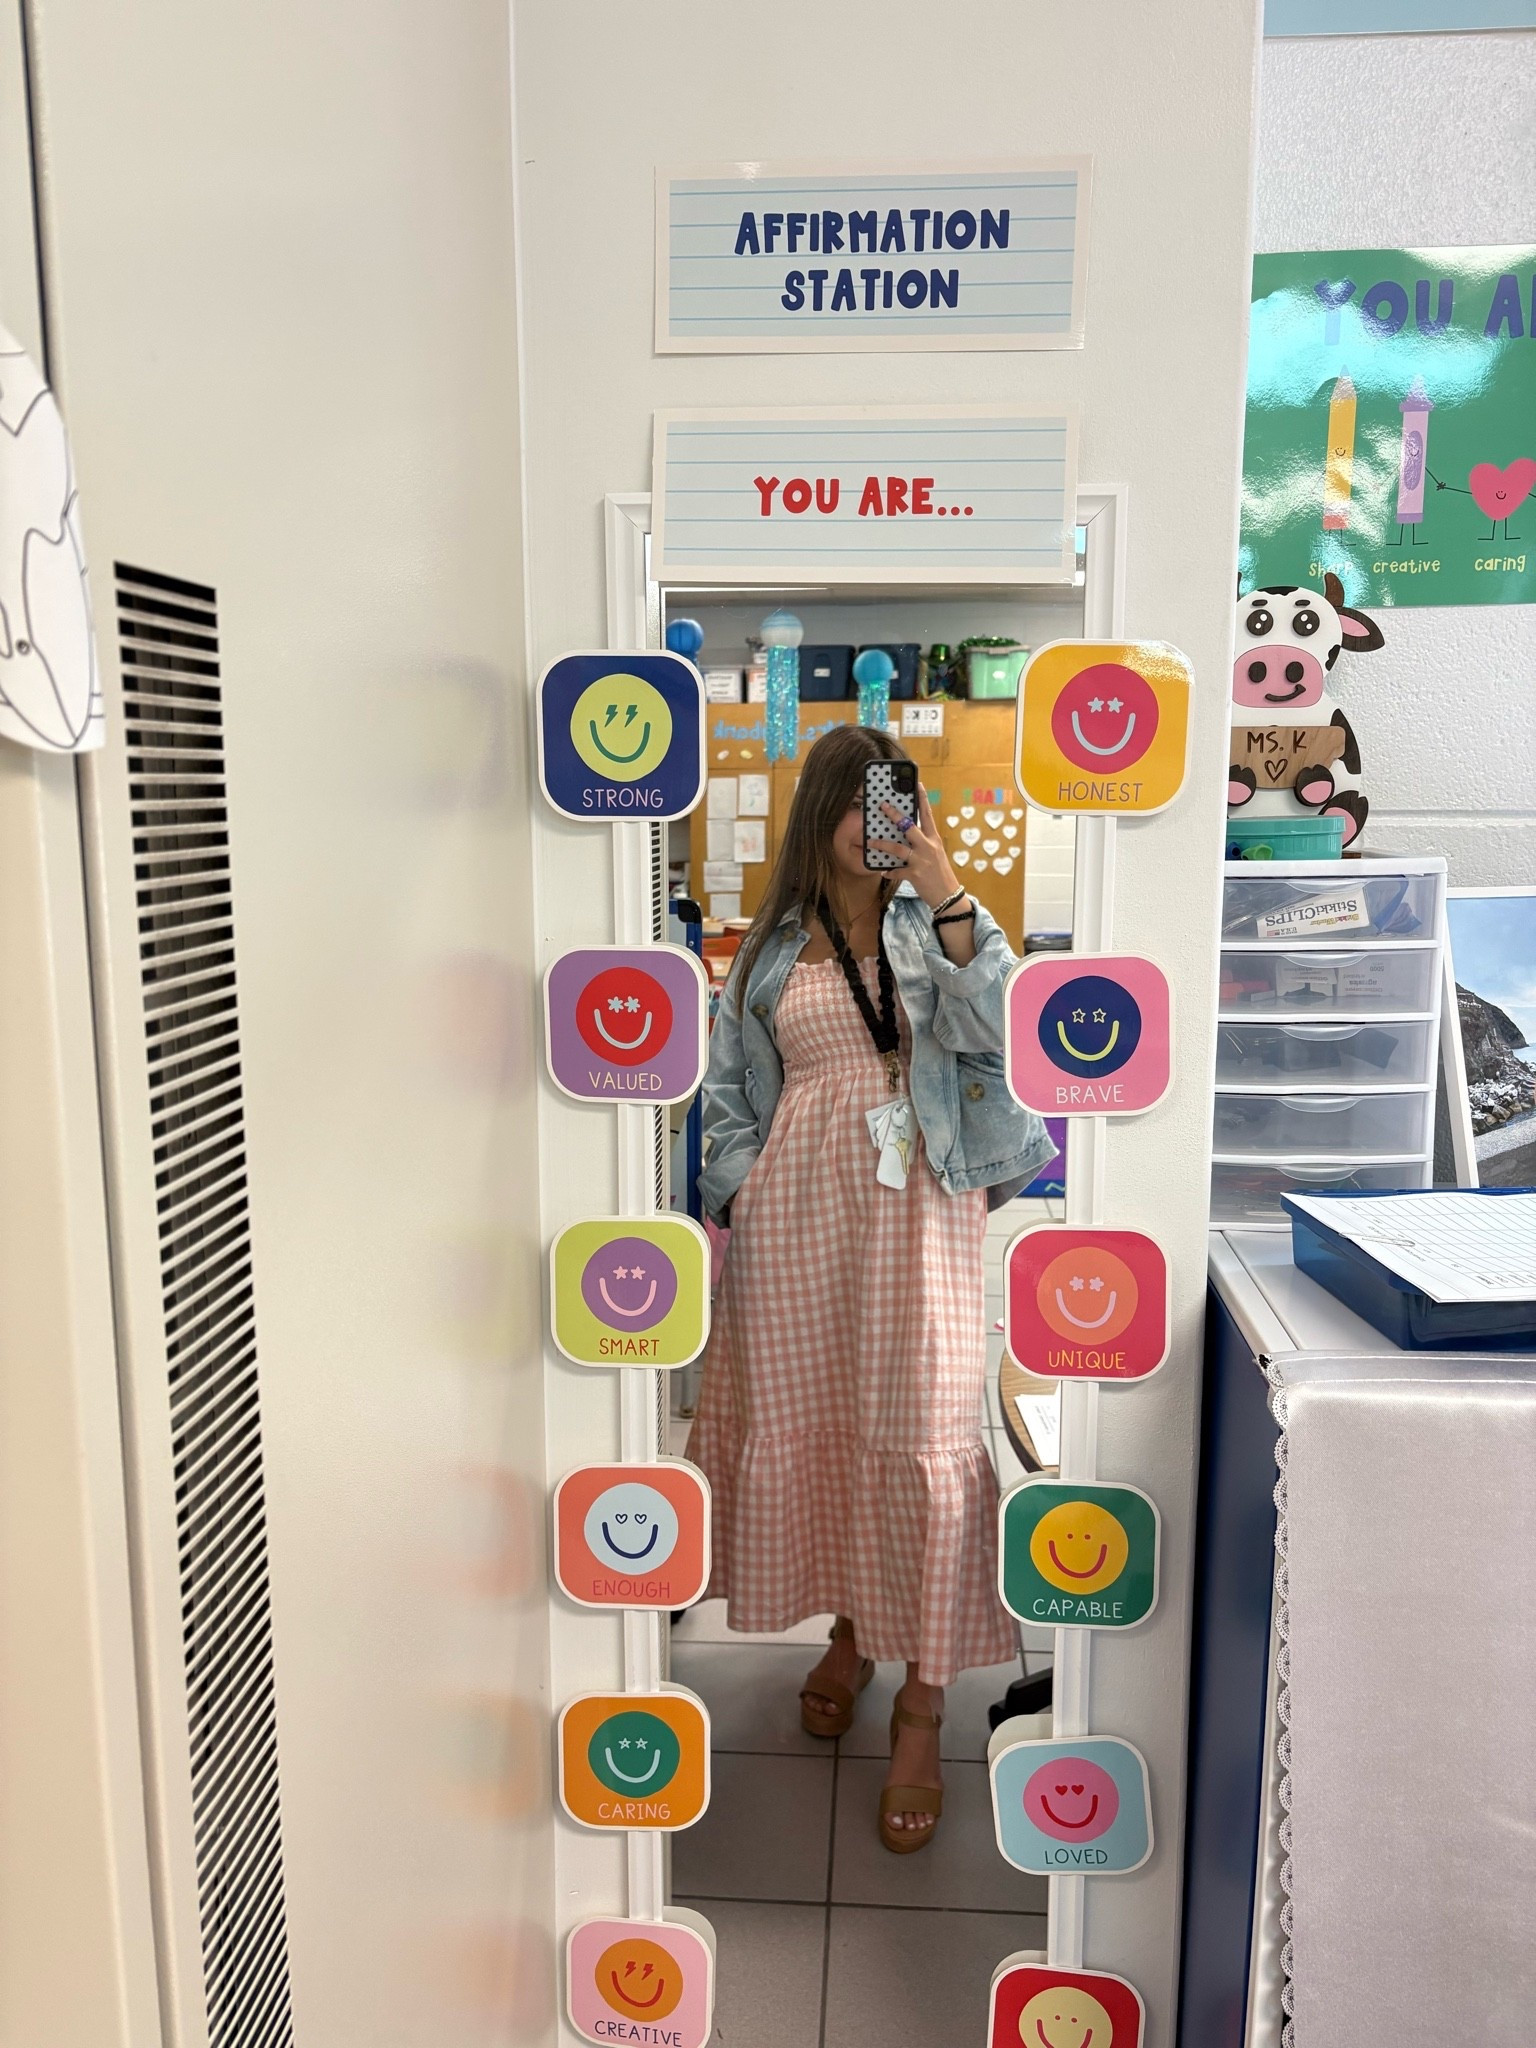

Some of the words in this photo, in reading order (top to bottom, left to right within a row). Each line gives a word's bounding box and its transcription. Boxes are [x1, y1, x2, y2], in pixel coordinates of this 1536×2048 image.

[734, 208, 1010, 255] AFFIRMATION
[781, 268, 959, 311] STATION
[1313, 278, 1454, 346] YOU
[753, 476, 840, 516] YOU
[858, 476, 974, 516] ARE...
[1373, 558, 1441, 574] creative
[1474, 554, 1526, 573] caring
[1247, 731, 1284, 753] MS.
[1293, 730, 1307, 754] K
[582, 788, 664, 808] STRONG
[1058, 781, 1143, 802] HONEST
[1264, 900, 1358, 927] StikkiCLIPS
[588, 1072, 662, 1091] VALUED
[1056, 1084, 1125, 1104] BRAVE
[599, 1338, 660, 1356] SMART
[1048, 1349, 1126, 1369] UNIQUE
[592, 1579, 670, 1598] ENOUGH
[1033, 1598, 1123, 1618] CAPABLE
[598, 1803, 671, 1820] CARING
[1044, 1848, 1108, 1865] LOVED
[594, 2020, 682, 2047] CREATIVE
